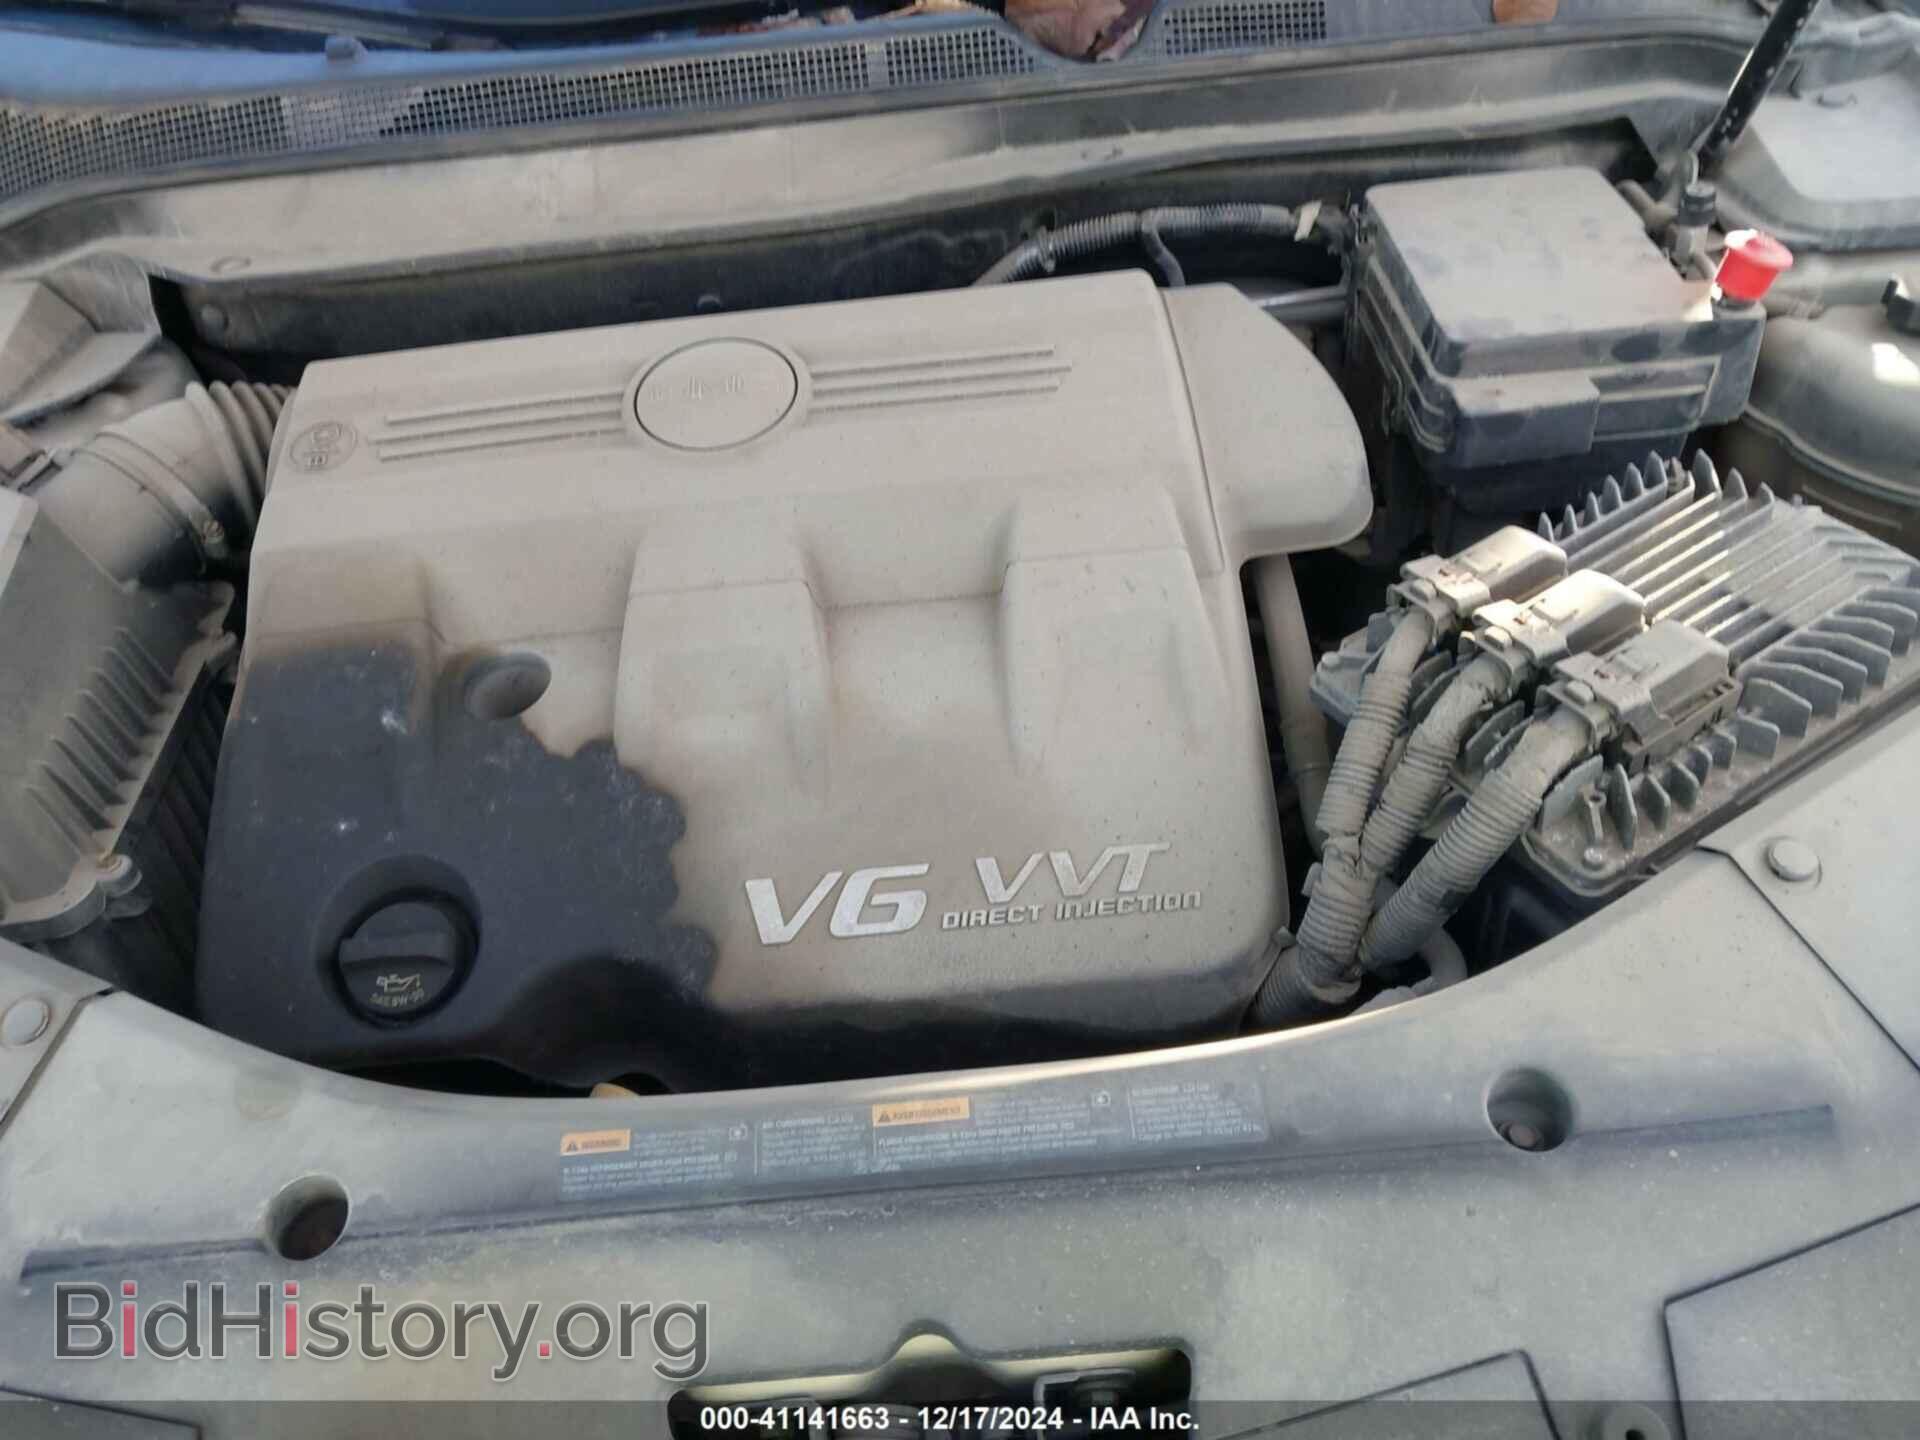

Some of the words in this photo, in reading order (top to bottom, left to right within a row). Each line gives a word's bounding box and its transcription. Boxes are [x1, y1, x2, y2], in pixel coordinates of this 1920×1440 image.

[745, 863, 930, 945] V6
[975, 842, 1171, 904] VVT
[942, 904, 1044, 929] DIRECT
[1055, 891, 1202, 920] INJECTION
